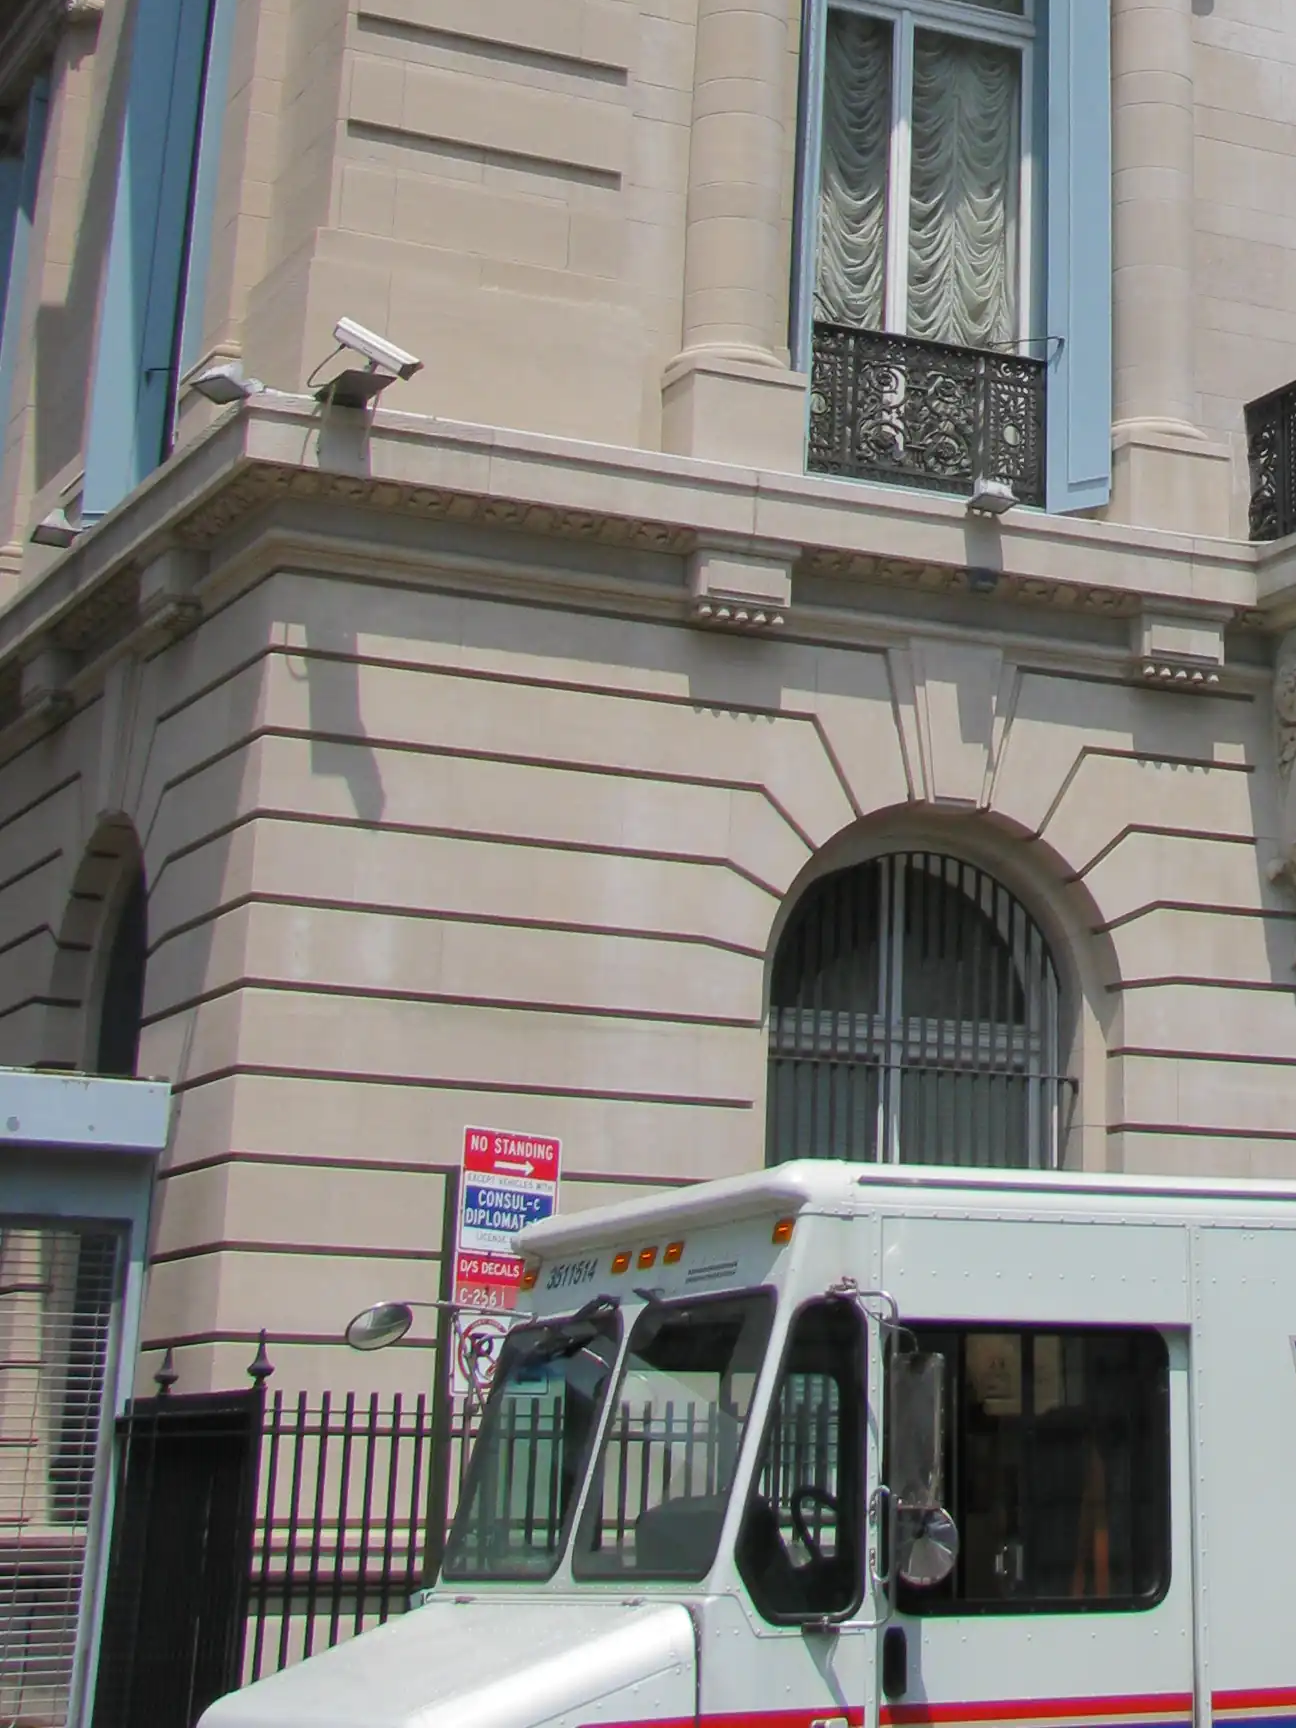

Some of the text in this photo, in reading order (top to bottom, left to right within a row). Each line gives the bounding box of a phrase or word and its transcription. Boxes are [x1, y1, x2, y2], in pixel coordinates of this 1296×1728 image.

[471, 1134, 554, 1161] NO STANDING
[460, 1259, 520, 1277] D/S DECALS
[546, 1258, 599, 1290] 3511514
